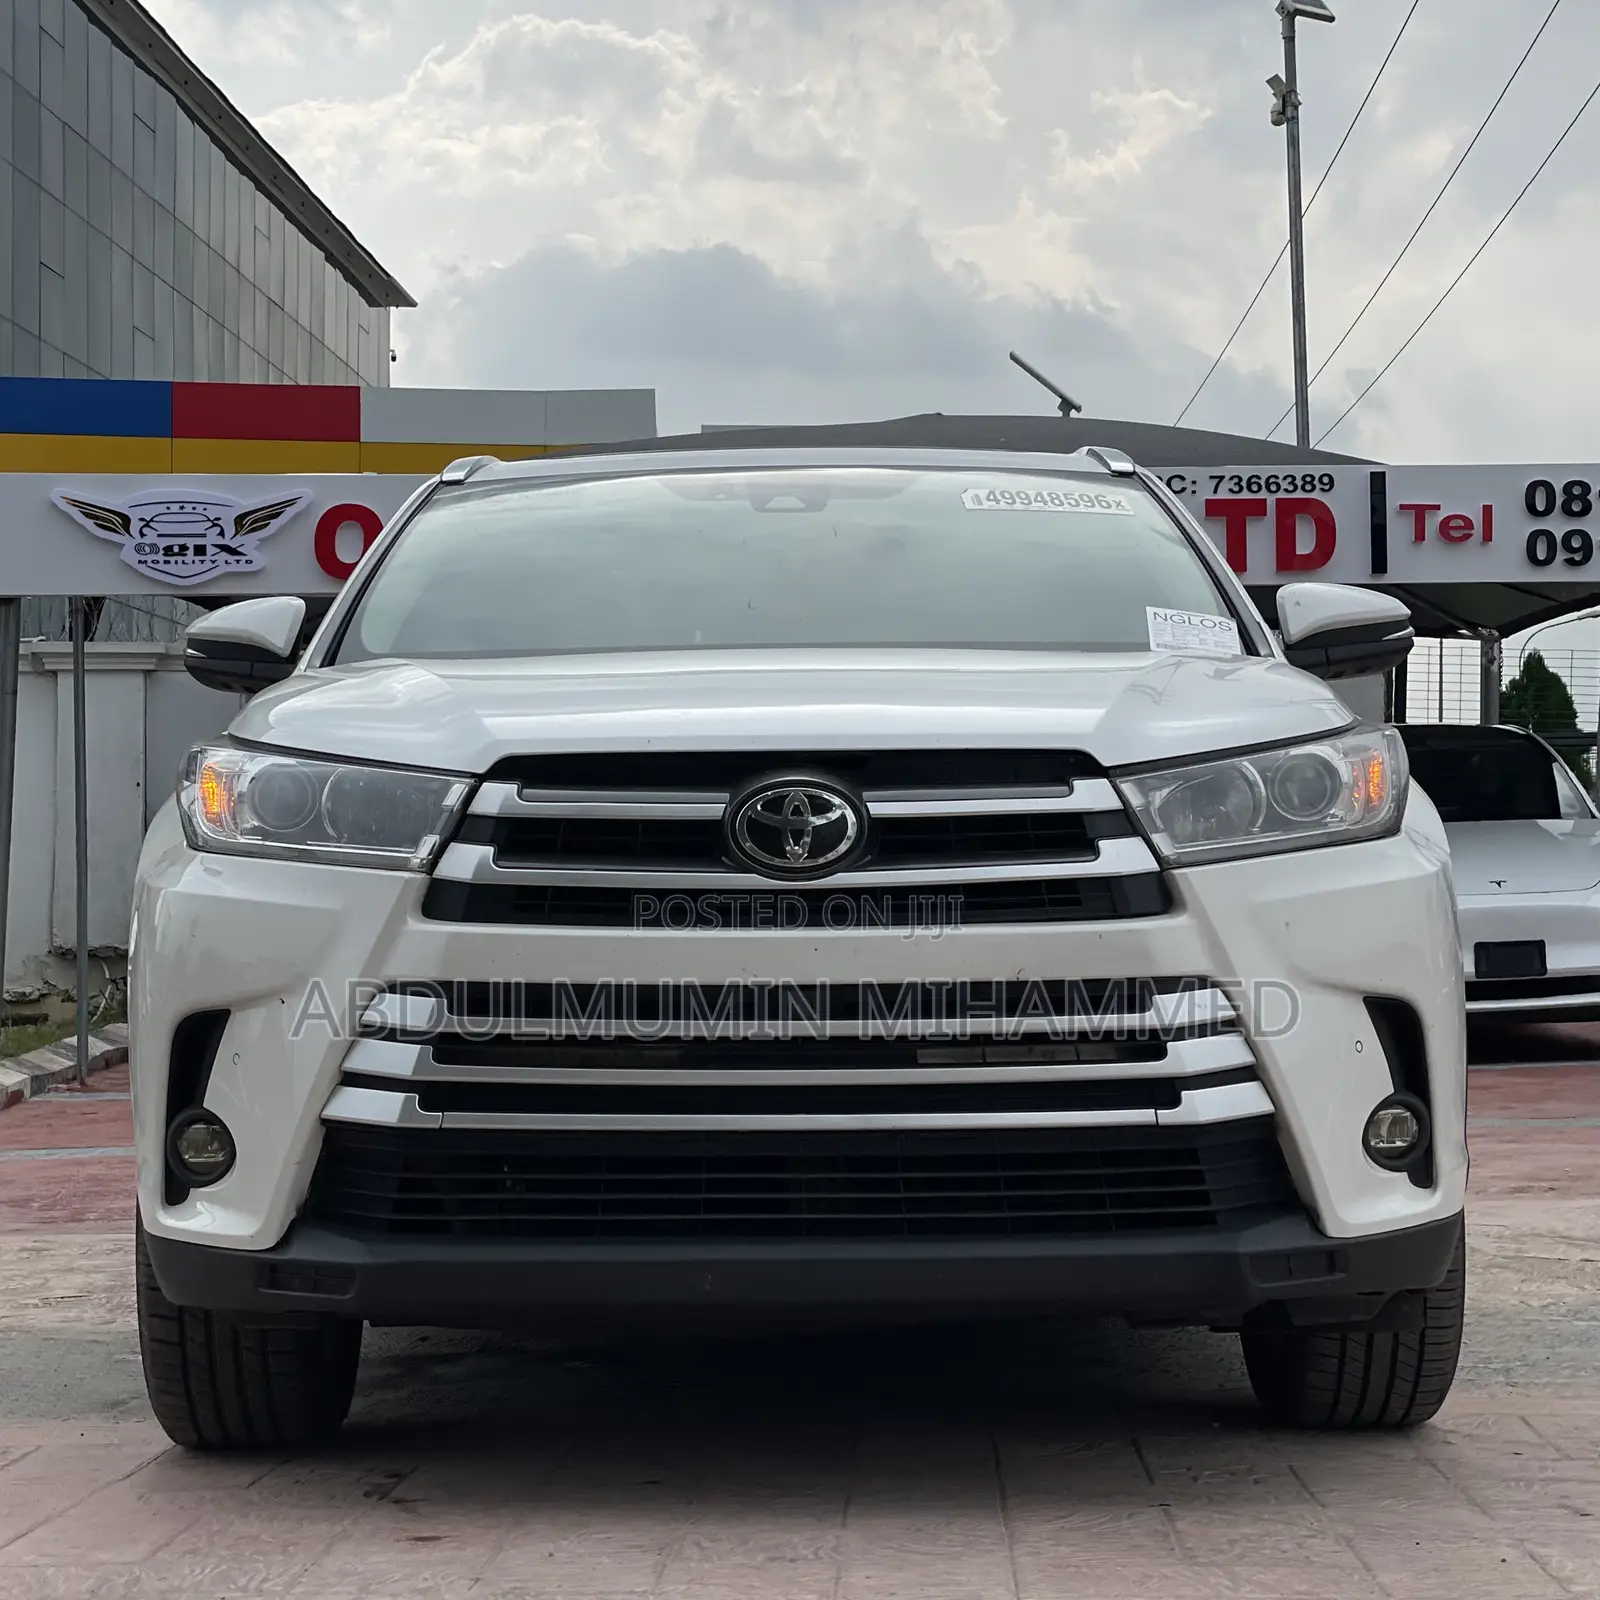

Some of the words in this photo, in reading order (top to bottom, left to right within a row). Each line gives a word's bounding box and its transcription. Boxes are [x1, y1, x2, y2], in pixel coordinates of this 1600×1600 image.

[1155, 473, 1197, 495] C:
[1209, 473, 1335, 494] 7366389
[1525, 479, 1600, 517] 08
[1399, 504, 1493, 543] Tel
[1153, 611, 1232, 632] NGLOS
